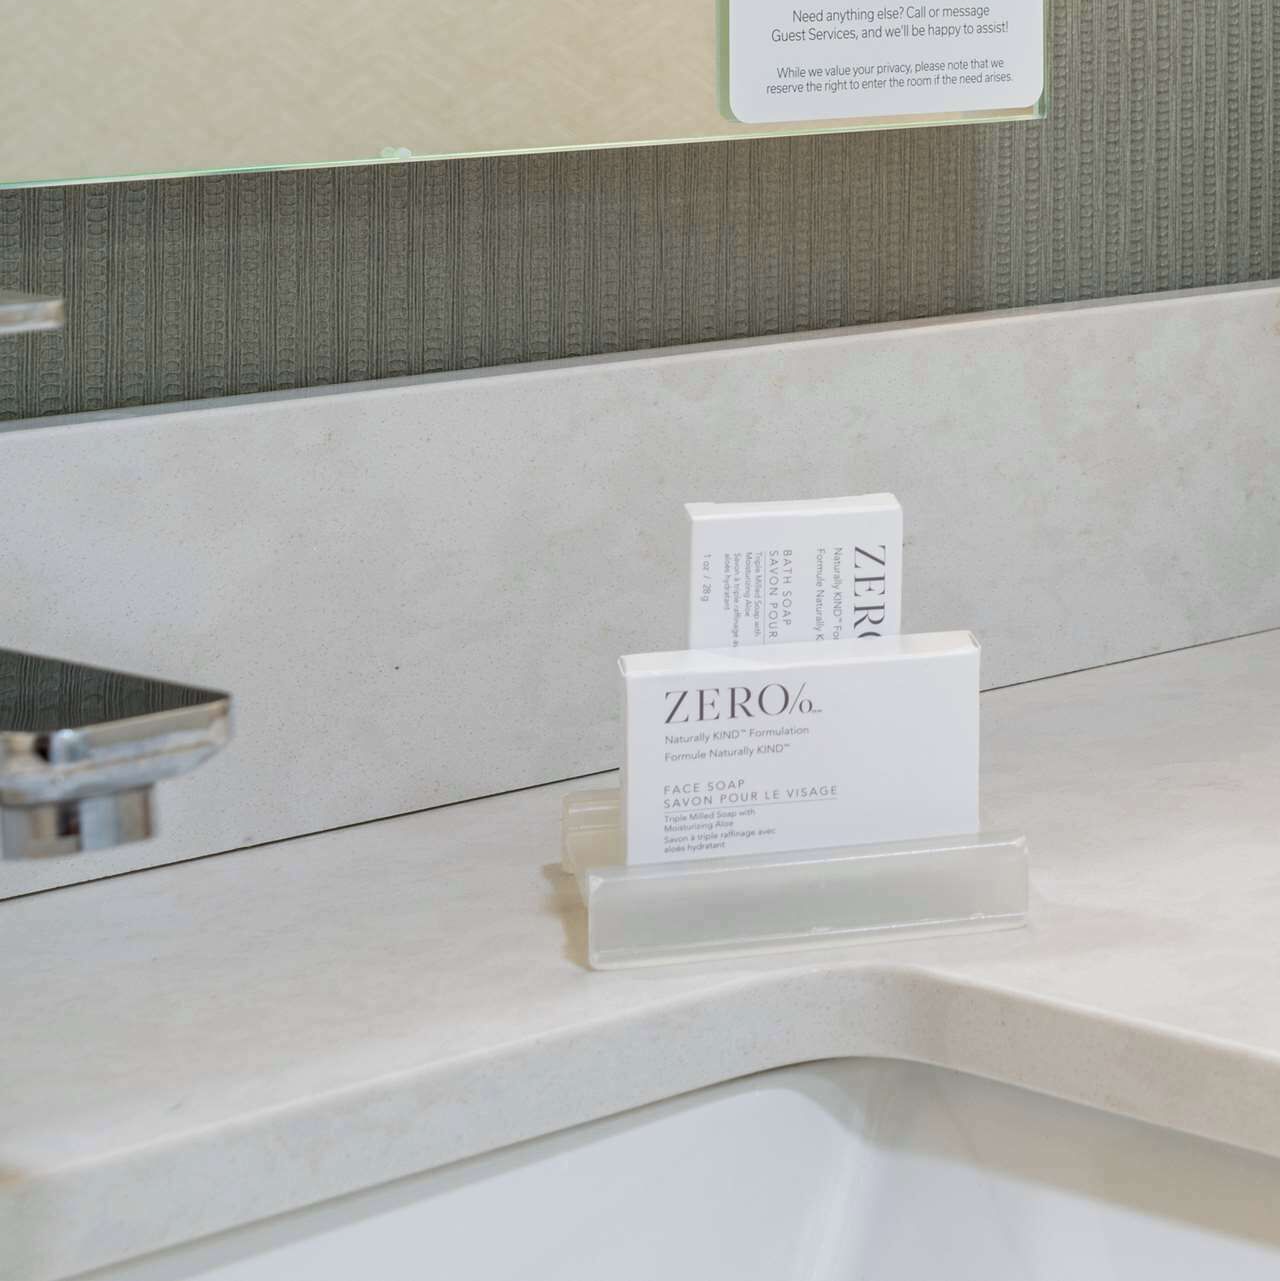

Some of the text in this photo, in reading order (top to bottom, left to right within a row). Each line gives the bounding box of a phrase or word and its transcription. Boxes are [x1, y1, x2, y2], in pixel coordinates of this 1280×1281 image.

[793, 5, 990, 24] Need anything else? Call or message
[772, 29, 806, 42] Guest
[808, 27, 858, 41] Services,
[861, 26, 882, 39] and
[912, 24, 925, 37] be
[928, 24, 961, 38] happy
[963, 24, 973, 34] to
[976, 21, 1008, 34] assist!
[777, 65, 805, 78] While
[808, 68, 823, 77] we
[825, 65, 850, 76] value
[852, 66, 874, 77] your
[915, 61, 945, 74] please
[947, 60, 968, 71] note
[970, 59, 988, 69] that
[991, 59, 1004, 68] we
[767, 83, 803, 94] reserve
[806, 81, 822, 92] the
[825, 80, 847, 93] right
[850, 80, 860, 90] to
[862, 79, 886, 89] enter
[889, 76, 904, 88] the
[906, 76, 932, 87] room
[934, 75, 940, 85] if
[942, 73, 957, 85] the
[959, 73, 982, 84] need
[769, 550, 779, 638] SAVON POUR
[782, 550, 792, 625] BATH SOAP
[665, 731, 711, 744] Naturally
[749, 726, 809, 737] Formulation
[665, 752, 706, 762] Formule
[709, 747, 753, 758] Naturally
[664, 779, 745, 794] FACE SOAP
[664, 786, 837, 808] SAVON POUR LE VISAGE
[664, 815, 687, 823] Triple
[689, 812, 714, 820] Milled
[717, 811, 737, 819] Soap
